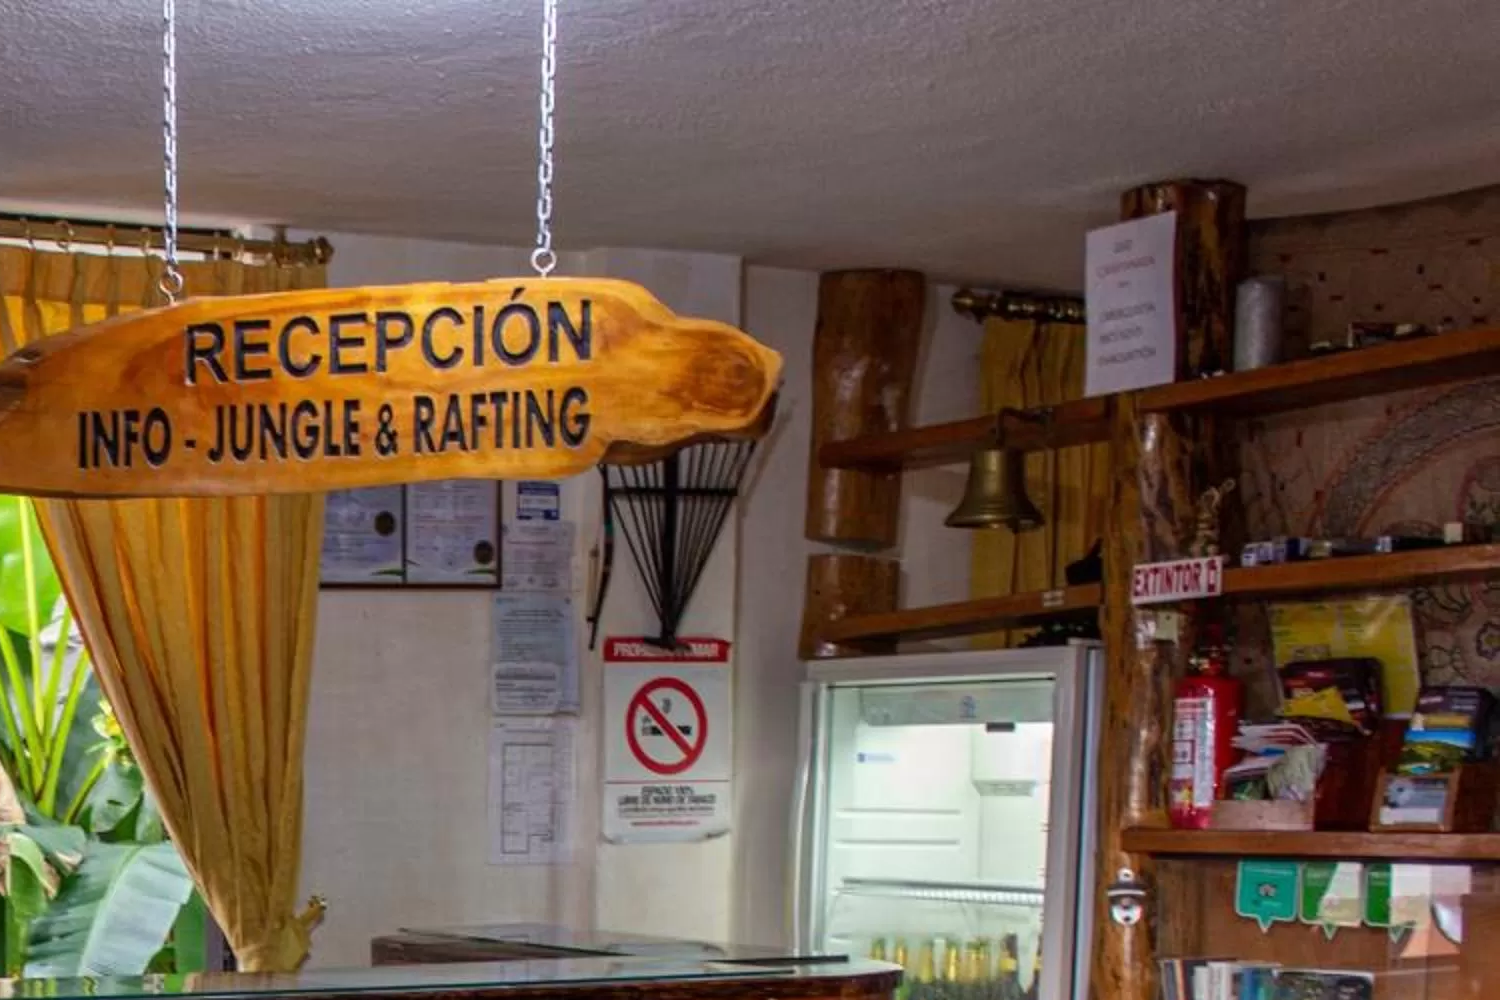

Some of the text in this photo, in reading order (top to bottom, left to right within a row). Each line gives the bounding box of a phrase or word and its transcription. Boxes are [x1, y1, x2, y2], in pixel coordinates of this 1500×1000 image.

[184, 287, 594, 386] RECEPCIÓN
[77, 406, 172, 470] INFO
[207, 398, 361, 464] JUNGLE
[374, 402, 399, 457] &
[412, 386, 592, 455] RAFTING
[1134, 562, 1201, 597] EXTINTOR
